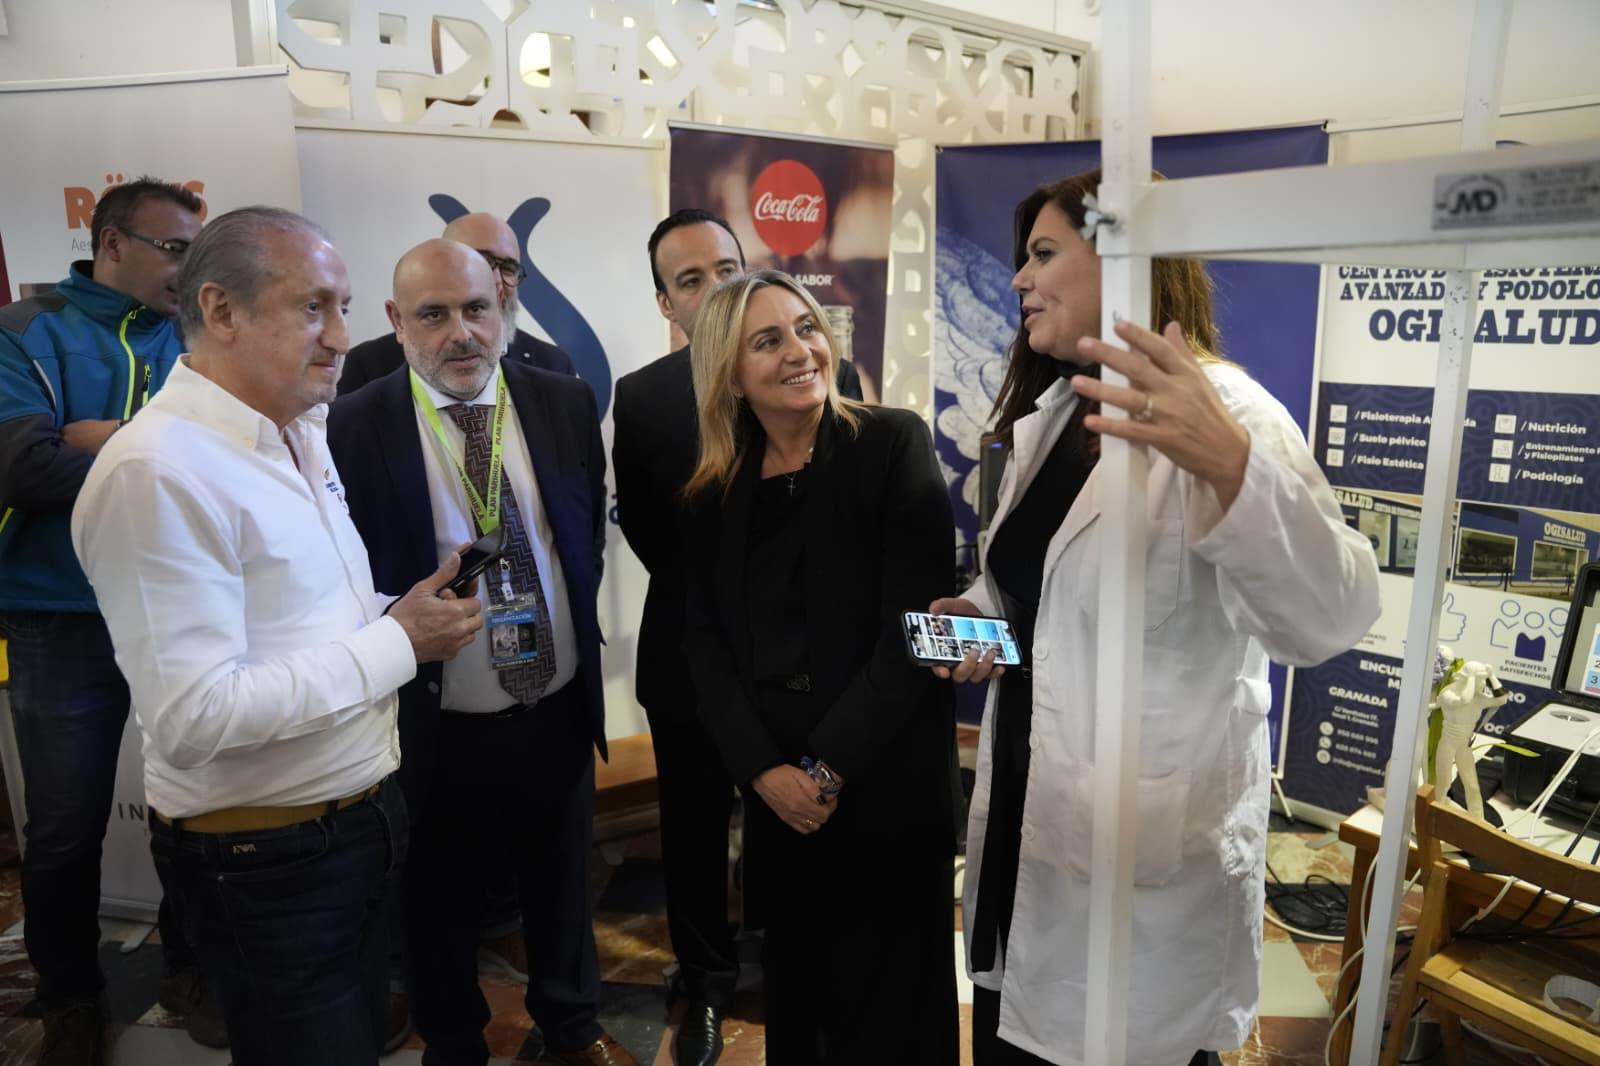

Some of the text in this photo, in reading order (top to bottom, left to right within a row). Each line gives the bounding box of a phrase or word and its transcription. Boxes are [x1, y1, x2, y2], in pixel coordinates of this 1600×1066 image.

[1340, 281, 1446, 300] AVANZAD
[1369, 308, 1600, 345] OGIALUD
[488, 496, 498, 518] PLAN
[1328, 686, 1389, 708] GRANADA
